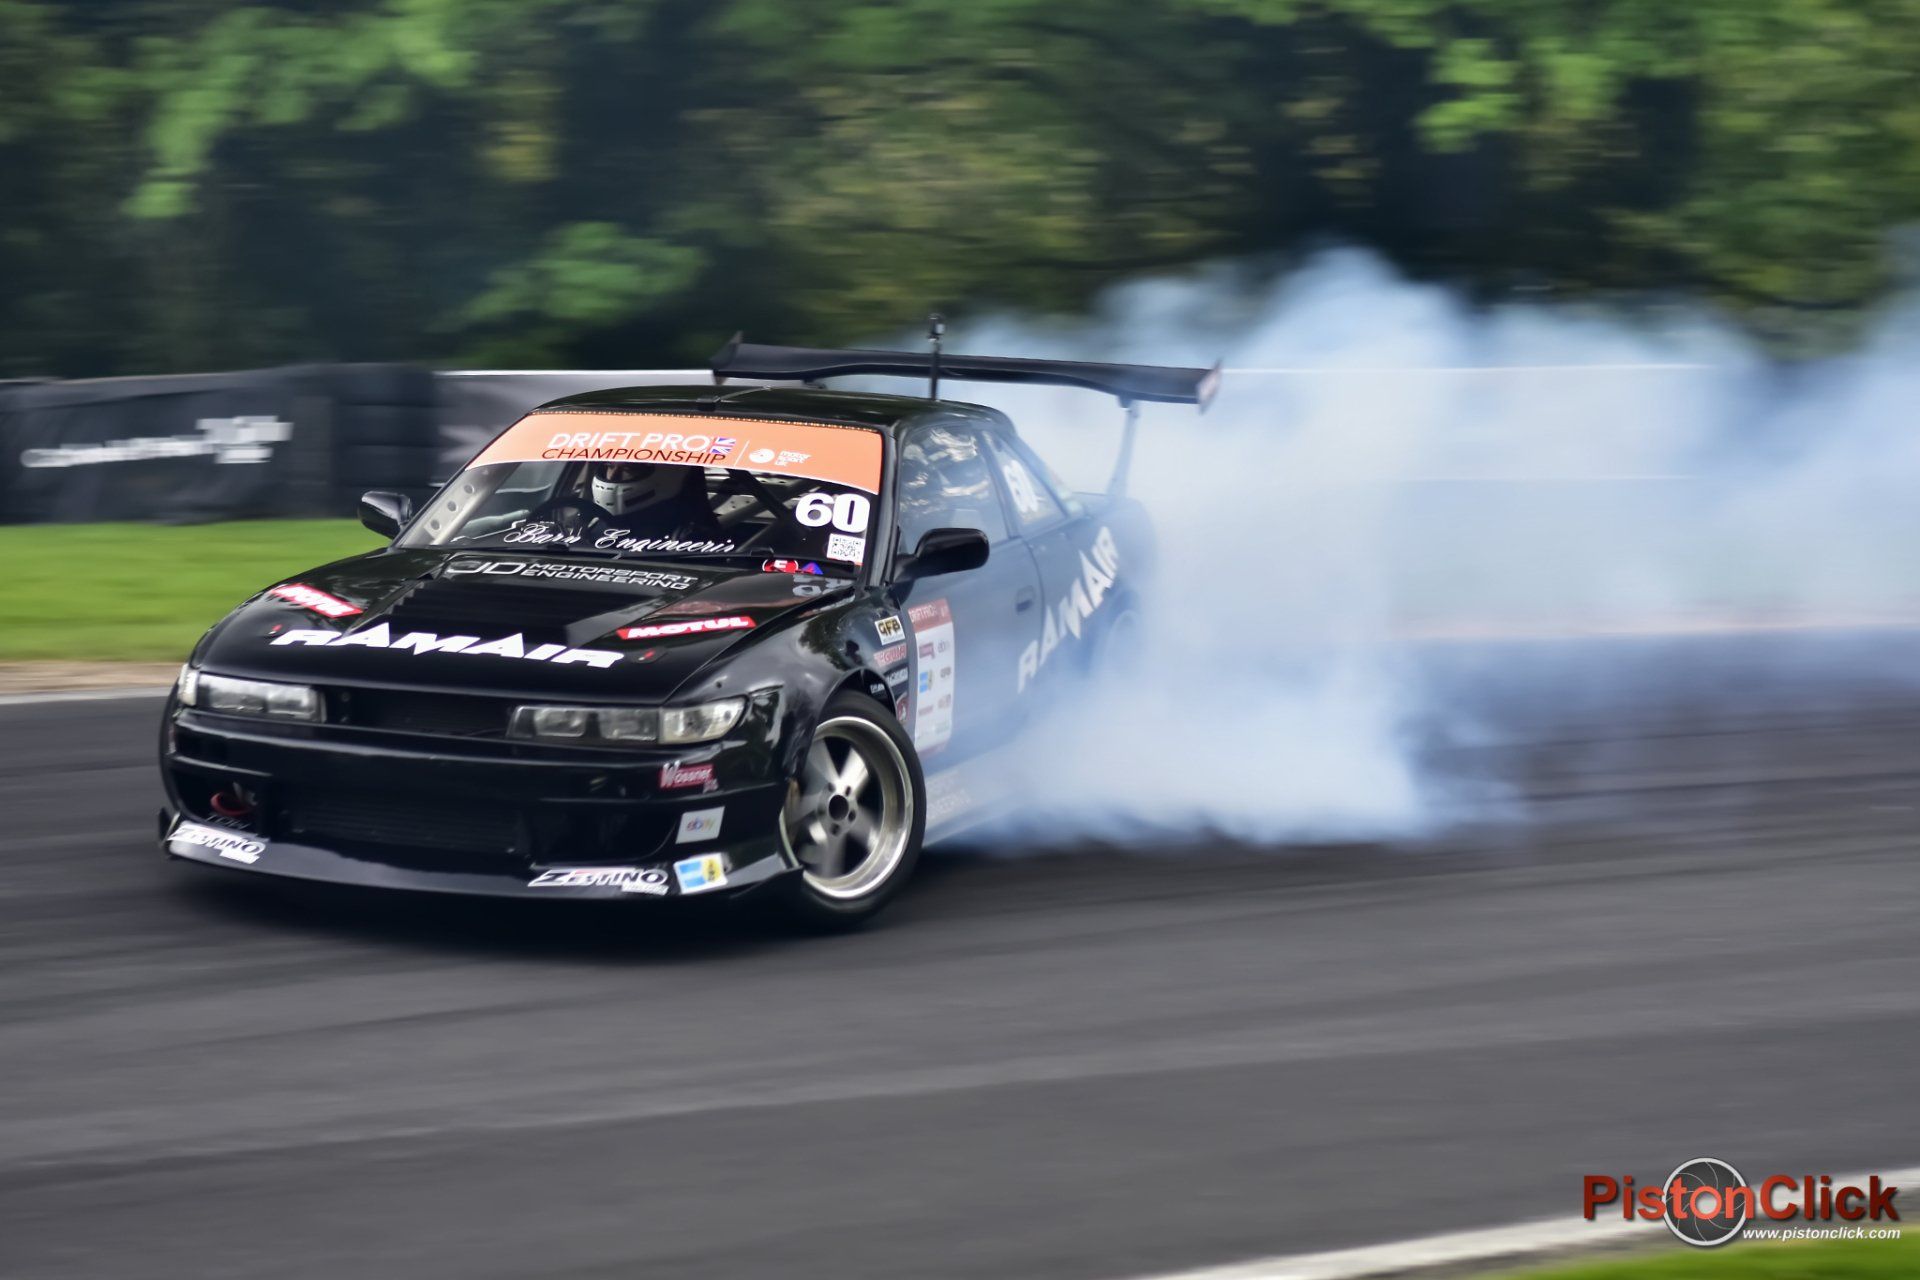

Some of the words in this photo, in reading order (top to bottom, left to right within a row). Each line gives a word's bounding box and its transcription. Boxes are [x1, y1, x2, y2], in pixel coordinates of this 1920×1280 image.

[547, 431, 640, 449] DRIFT
[640, 433, 711, 452] PRO
[541, 447, 726, 465] CHAMPIONSHIP
[796, 492, 871, 533] 60
[520, 568, 691, 591] ENGINEERING
[528, 562, 699, 584] MOTORSPORT
[1017, 525, 1120, 695] RAMAIR
[627, 617, 749, 639] MOTUL
[877, 618, 901, 637] GFB
[269, 621, 625, 669] RAMAIR
[527, 867, 669, 888] ZETINO
